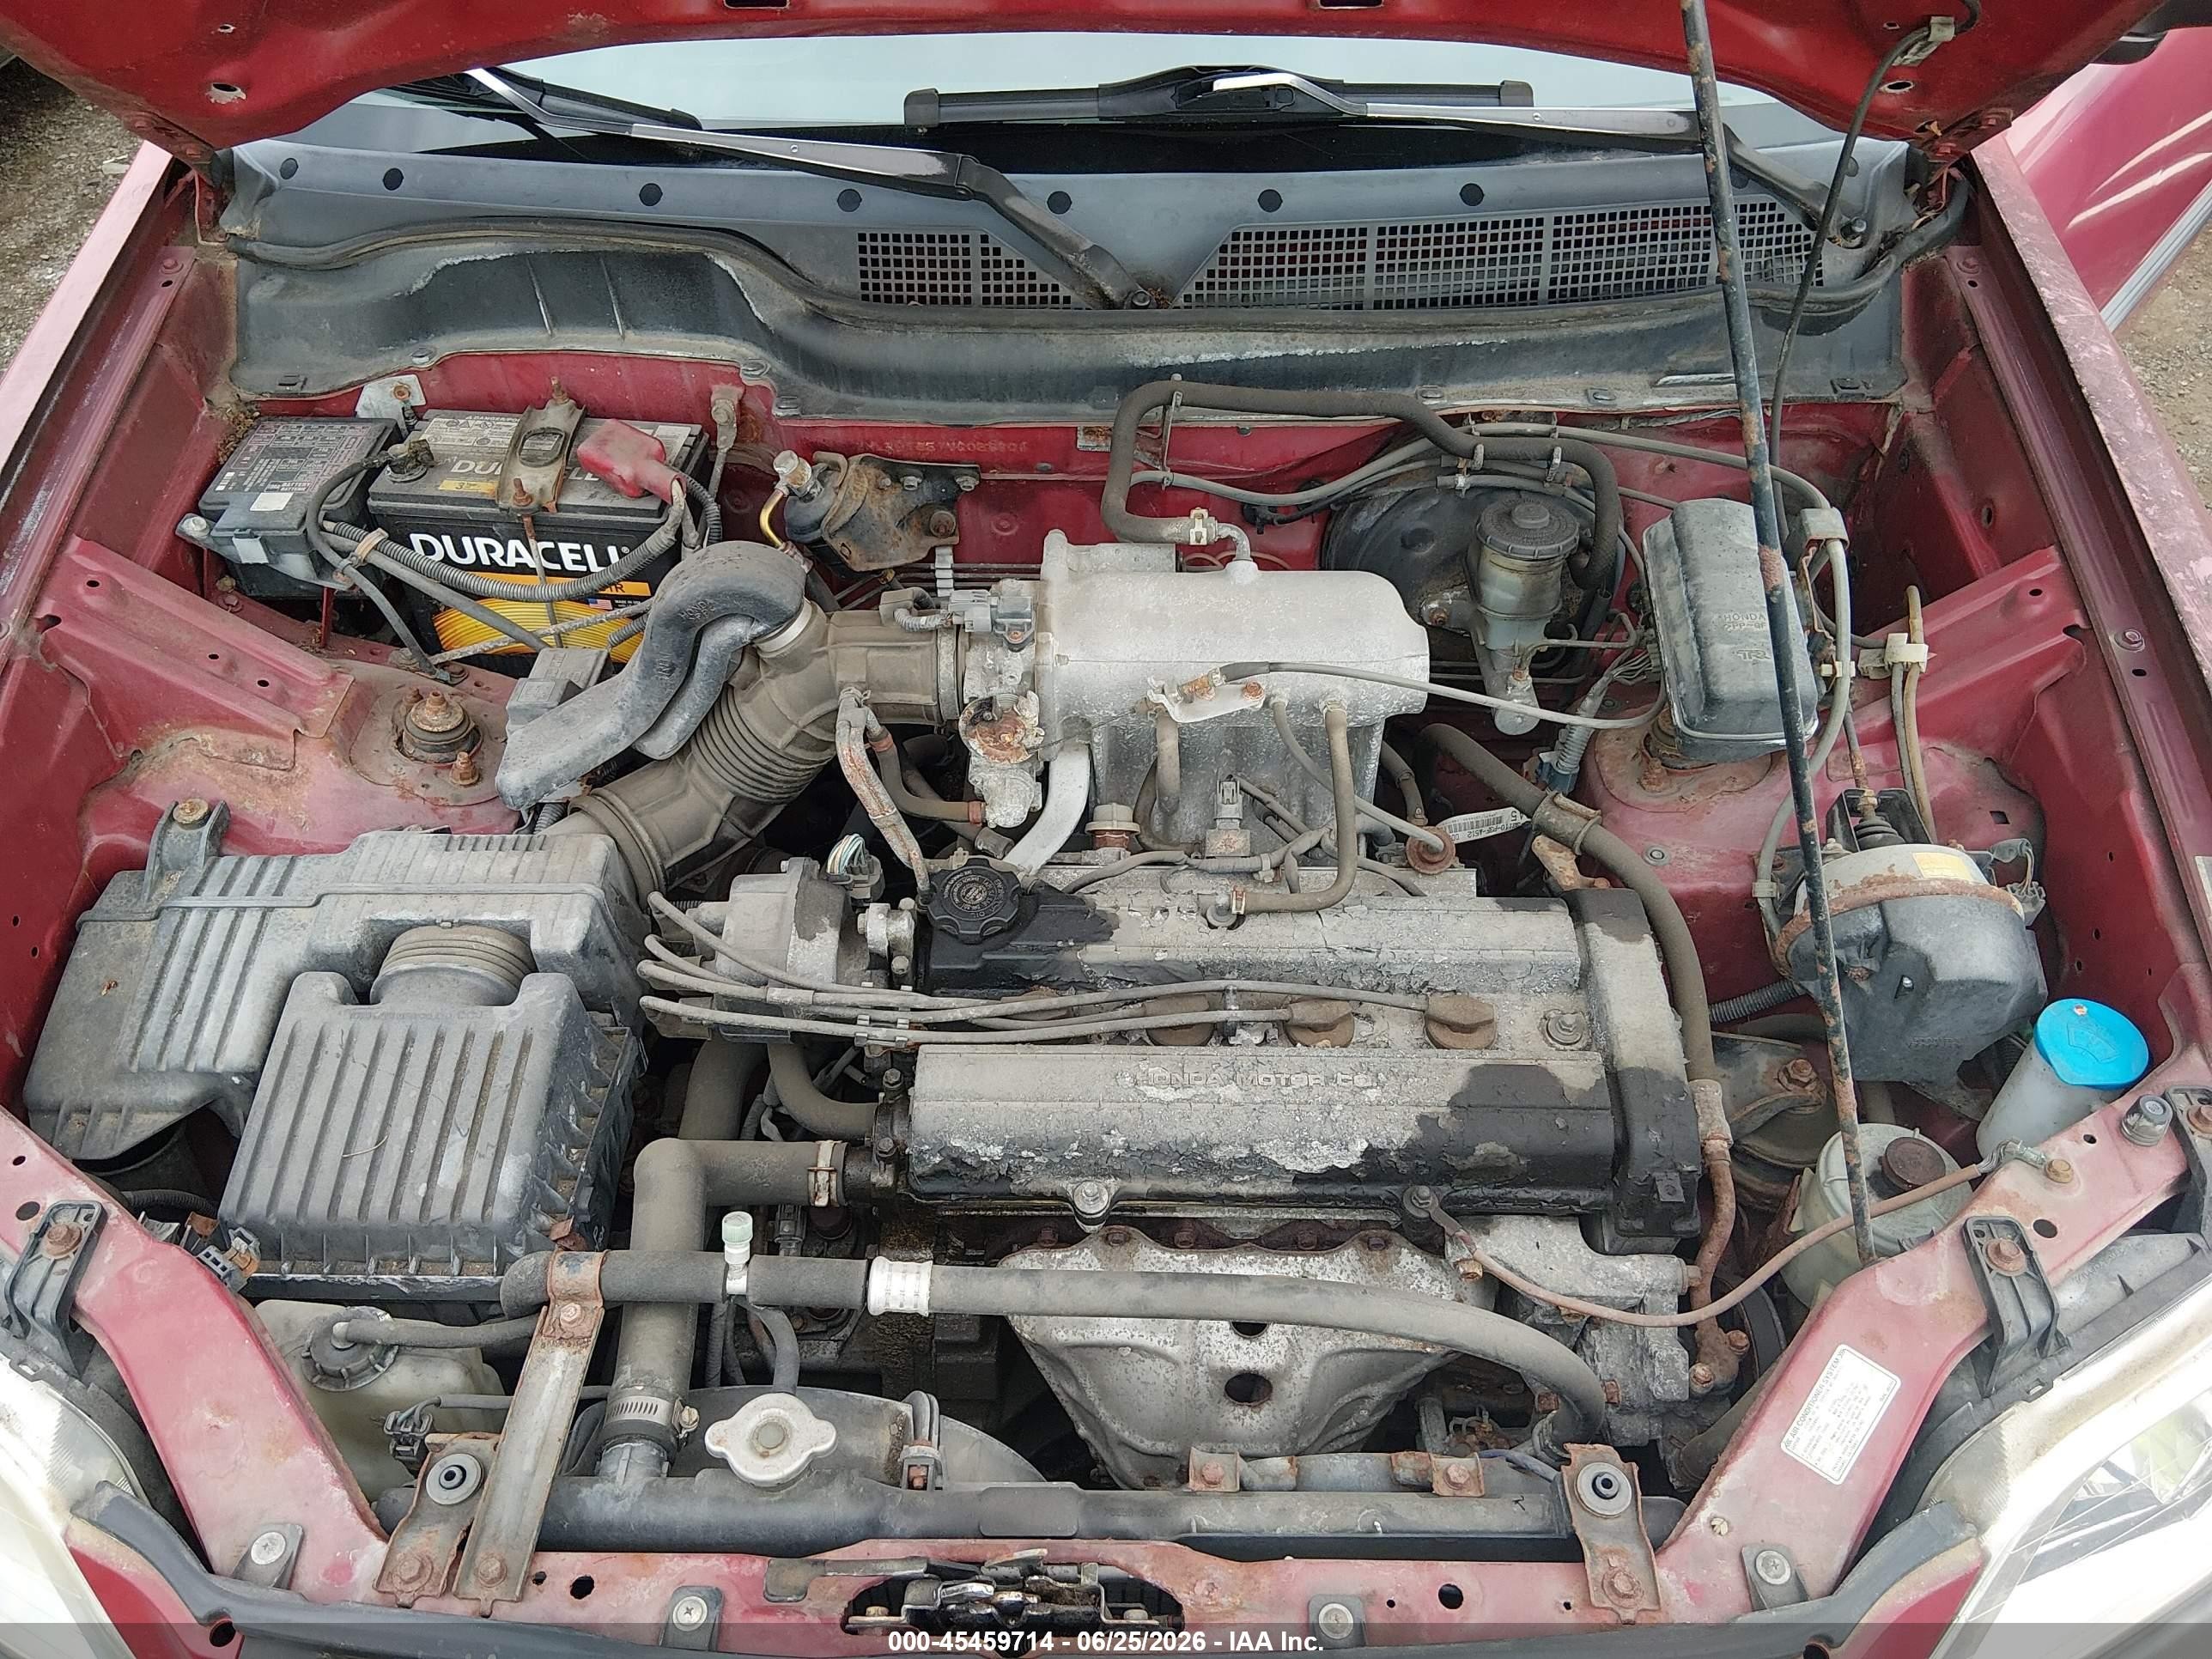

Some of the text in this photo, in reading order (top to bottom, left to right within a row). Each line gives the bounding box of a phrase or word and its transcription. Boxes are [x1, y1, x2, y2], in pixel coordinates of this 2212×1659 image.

[1723, 612, 1766, 621] HONDA
[1239, 1073, 1324, 1086] MOTOR
[1796, 1384, 1825, 1426] CONDITIONER
[1822, 1358, 1839, 1384] SYSTEM
